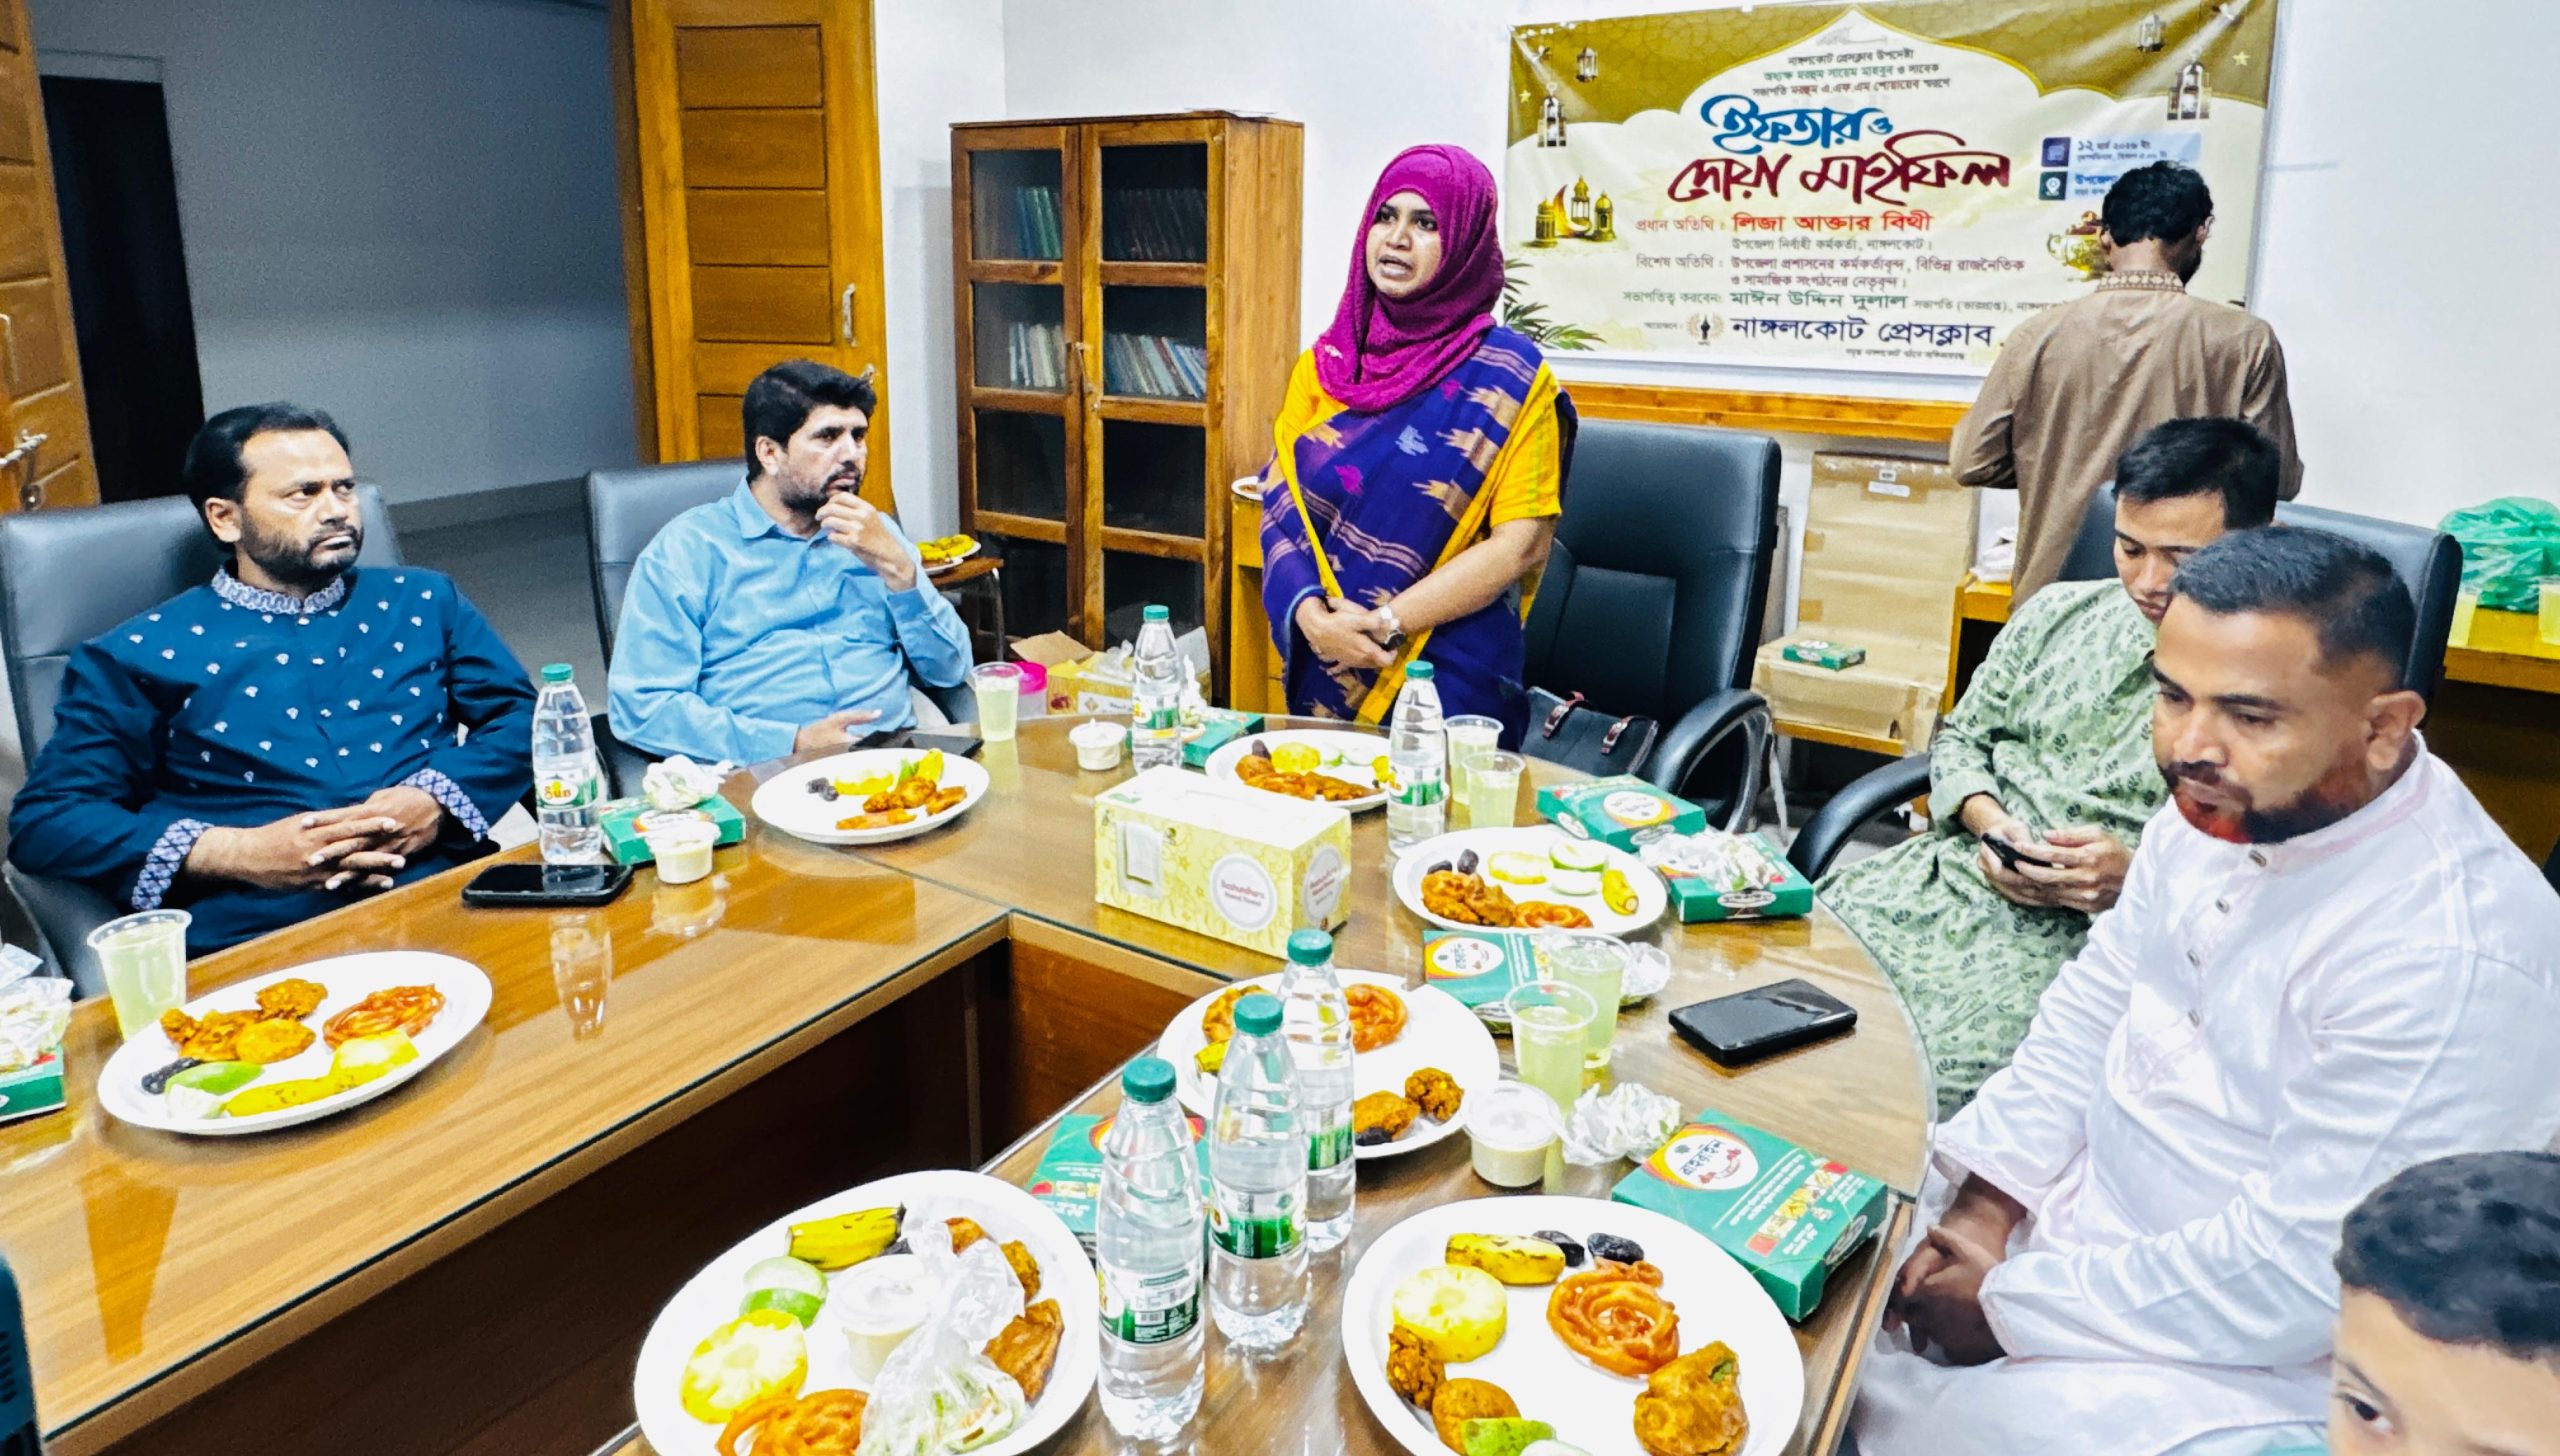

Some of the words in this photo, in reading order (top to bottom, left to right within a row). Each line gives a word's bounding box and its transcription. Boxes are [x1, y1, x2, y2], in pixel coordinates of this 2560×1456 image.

[1876, 48, 1915, 60] উপদেষ্টা
[1897, 65, 1905, 74] ও
[1908, 64, 1940, 74] সাবেক
[1752, 84, 1787, 96] সভাপতি
[1700, 94, 1885, 155] ইফতার
[1867, 114, 1894, 135] ও
[2077, 140, 2094, 151] ১২
[1667, 153, 1793, 202] দোয়া
[1799, 129, 2011, 206] মাহফিল
[1635, 219, 1668, 232] প্রধান
[1673, 215, 1715, 232] অতিথি
[1732, 211, 1785, 233] লিজা
[1794, 214, 1873, 232] আক্তার
[1881, 209, 1934, 232] বিথী
[1732, 237, 1774, 250] উপজেলা
[1779, 235, 1811, 250] নির্বাহী
[1636, 253, 1671, 269] বিশেষ
[1675, 254, 1714, 269] অতিথি
[1731, 255, 1778, 270] উপজেলা
[1781, 257, 1834, 270] প্রশাসনের
[1916, 255, 1952, 272] বিভিন্ন
[1957, 256, 2025, 272] রাজনৈতিক
[1731, 275, 1740, 285] ও
[1744, 273, 1792, 286] সামাজিক
[1797, 275, 1848, 288] সংগঠনের
[1623, 289, 1676, 306] সভাপতিত্ব
[1730, 289, 1780, 306] মাঈন
[1788, 289, 1845, 307] উদ্দিন
[1850, 294, 1909, 312] দুলাল
[1914, 299, 1954, 310] সভাপতি
[1730, 314, 1870, 341] নাঙ্গলকোট
[1878, 320, 1996, 347] প্রেসক্লাব
[544, 785, 571, 800] Sun
